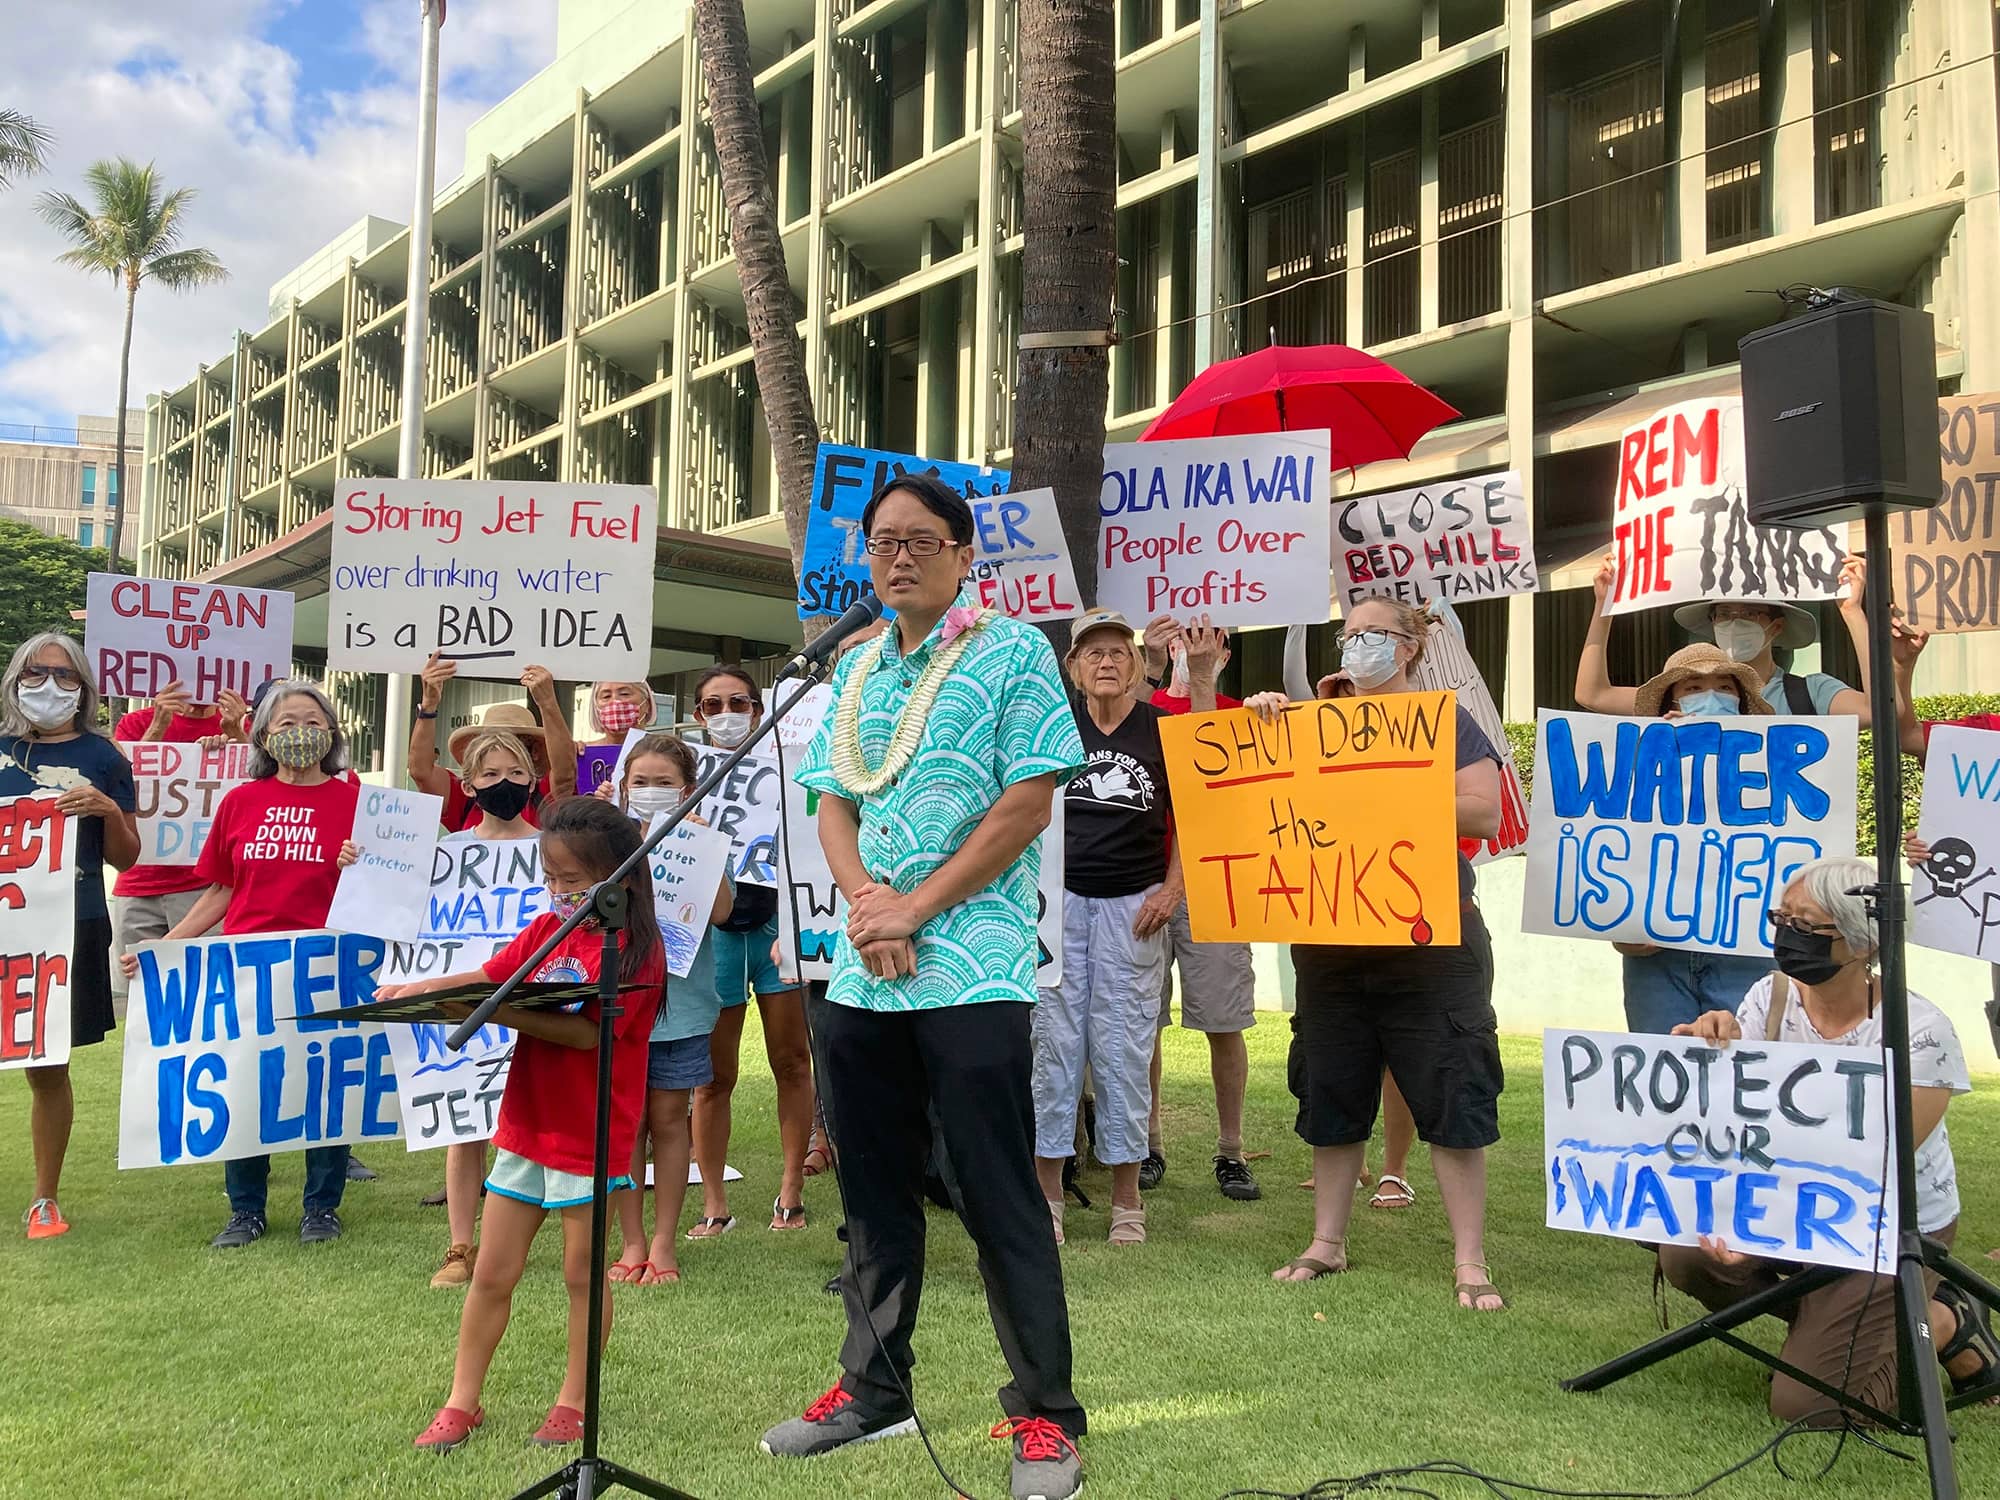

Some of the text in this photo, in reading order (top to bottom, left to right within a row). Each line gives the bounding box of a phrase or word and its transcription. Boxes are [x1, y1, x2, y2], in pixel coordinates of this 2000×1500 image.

[1098, 466, 1169, 516] OLA
[1243, 455, 1314, 504] WAI
[345, 491, 640, 543] Storing Jet Fuel
[974, 500, 1036, 554] ER
[1338, 480, 1512, 544] CLOSE
[1105, 519, 1306, 572] People Over
[1423, 527, 1521, 571] HILL
[1613, 506, 1675, 603] THE
[336, 555, 613, 600] over drinking water
[978, 572, 1074, 617] FUEL
[1147, 569, 1268, 612] Profits
[1431, 560, 1537, 597] TANKS
[111, 581, 268, 629] CLEAN
[345, 604, 632, 651] is a BAD IDEA
[166, 624, 210, 651] UP
[100, 648, 177, 698] RED
[1194, 704, 1304, 776] SHUT
[1317, 694, 1446, 759] DOWN
[1088, 750, 1155, 800] ANS FOR PEACE
[1546, 717, 1830, 827] WATER
[255, 825, 316, 842] DOWN
[264, 807, 315, 824] SHUT
[376, 823, 420, 842] Water
[1268, 797, 1337, 850] the
[243, 843, 325, 862] RED HILL
[653, 863, 685, 884] Our
[1200, 839, 1425, 928] TANKS
[390, 942, 463, 977] NOT
[137, 933, 387, 1047] WATER
[158, 1052, 232, 1166] IS
[1561, 1035, 1885, 1140] PROTECT
[412, 1089, 504, 1138] JET
[1664, 1122, 1776, 1171] OUR
[1564, 1155, 1865, 1257] WATER
